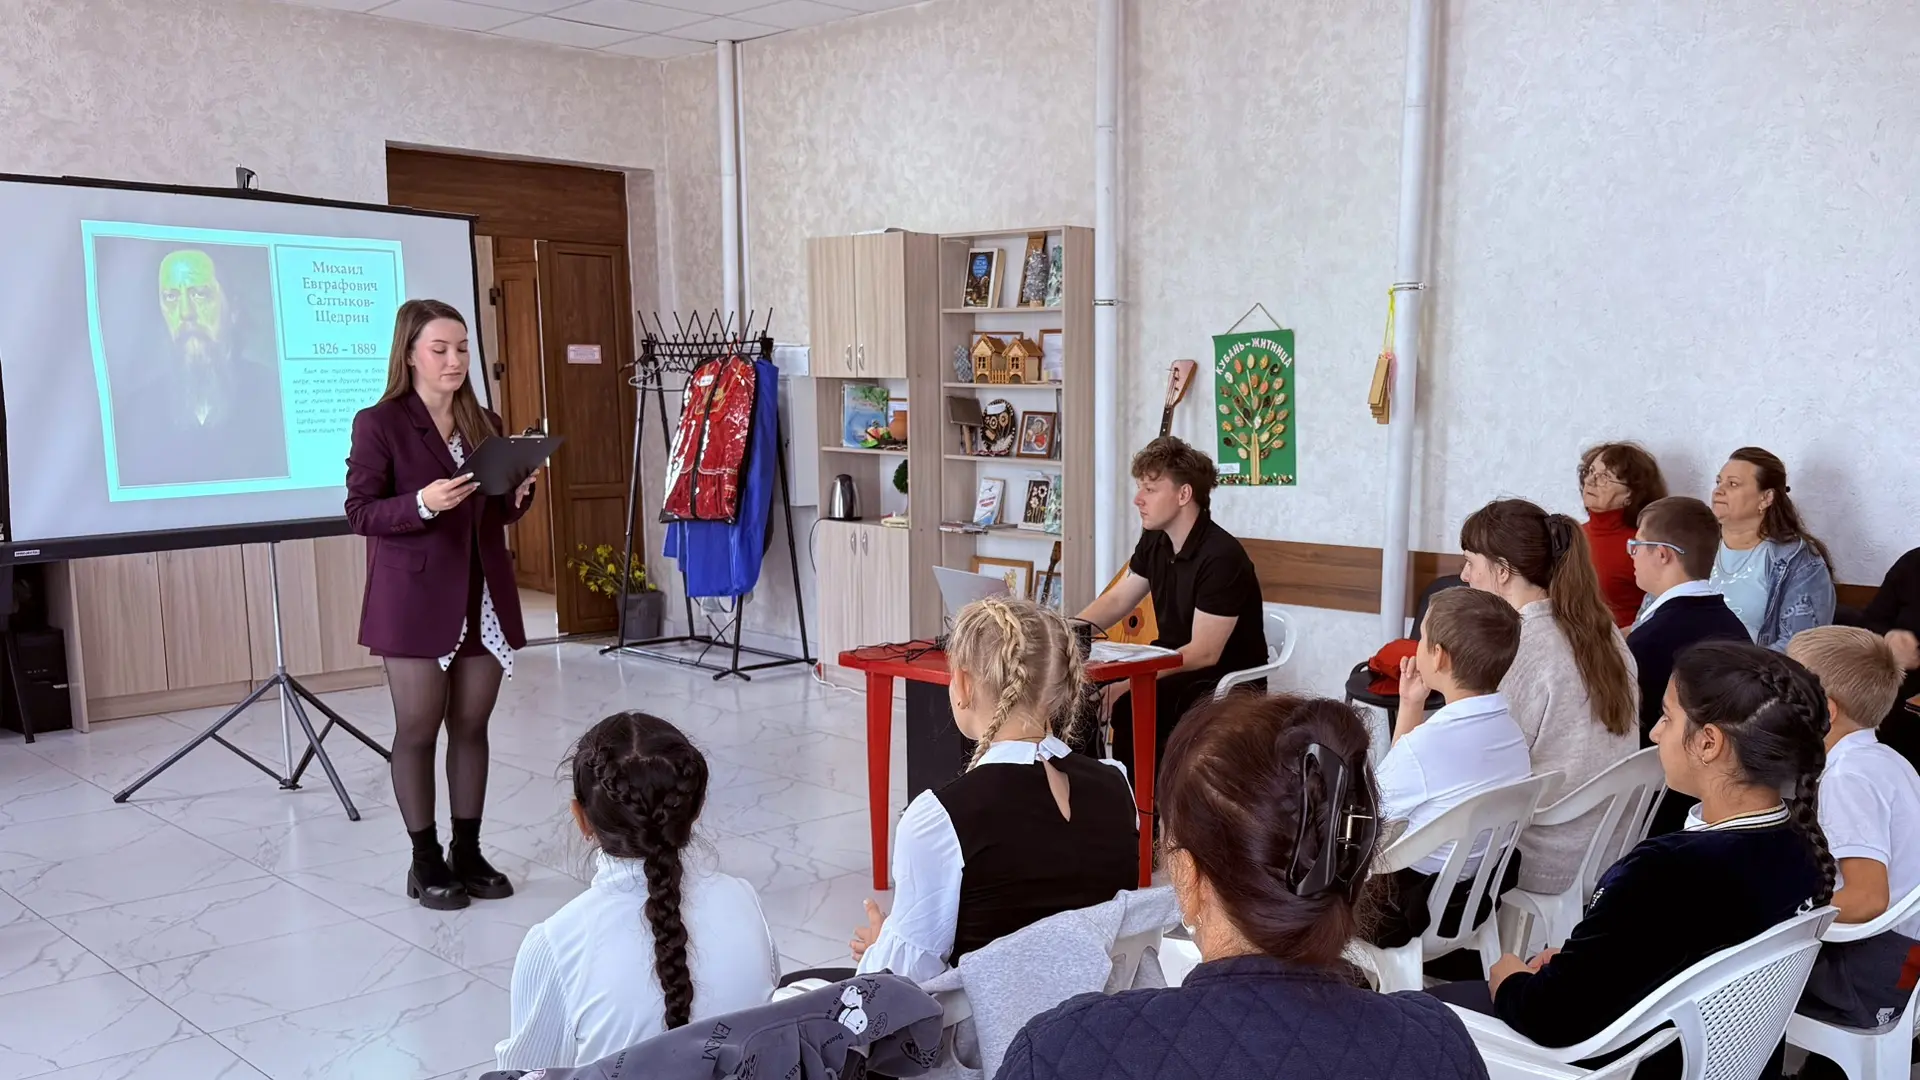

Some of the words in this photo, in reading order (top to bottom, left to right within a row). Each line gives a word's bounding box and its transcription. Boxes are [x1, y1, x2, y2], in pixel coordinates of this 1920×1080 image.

[312, 261, 364, 275] Михаил
[302, 277, 378, 294] Евграфович
[306, 293, 375, 307] Салтыков-
[315, 310, 369, 326] Щедрин
[312, 343, 339, 355] 1826
[350, 343, 377, 355] 1889
